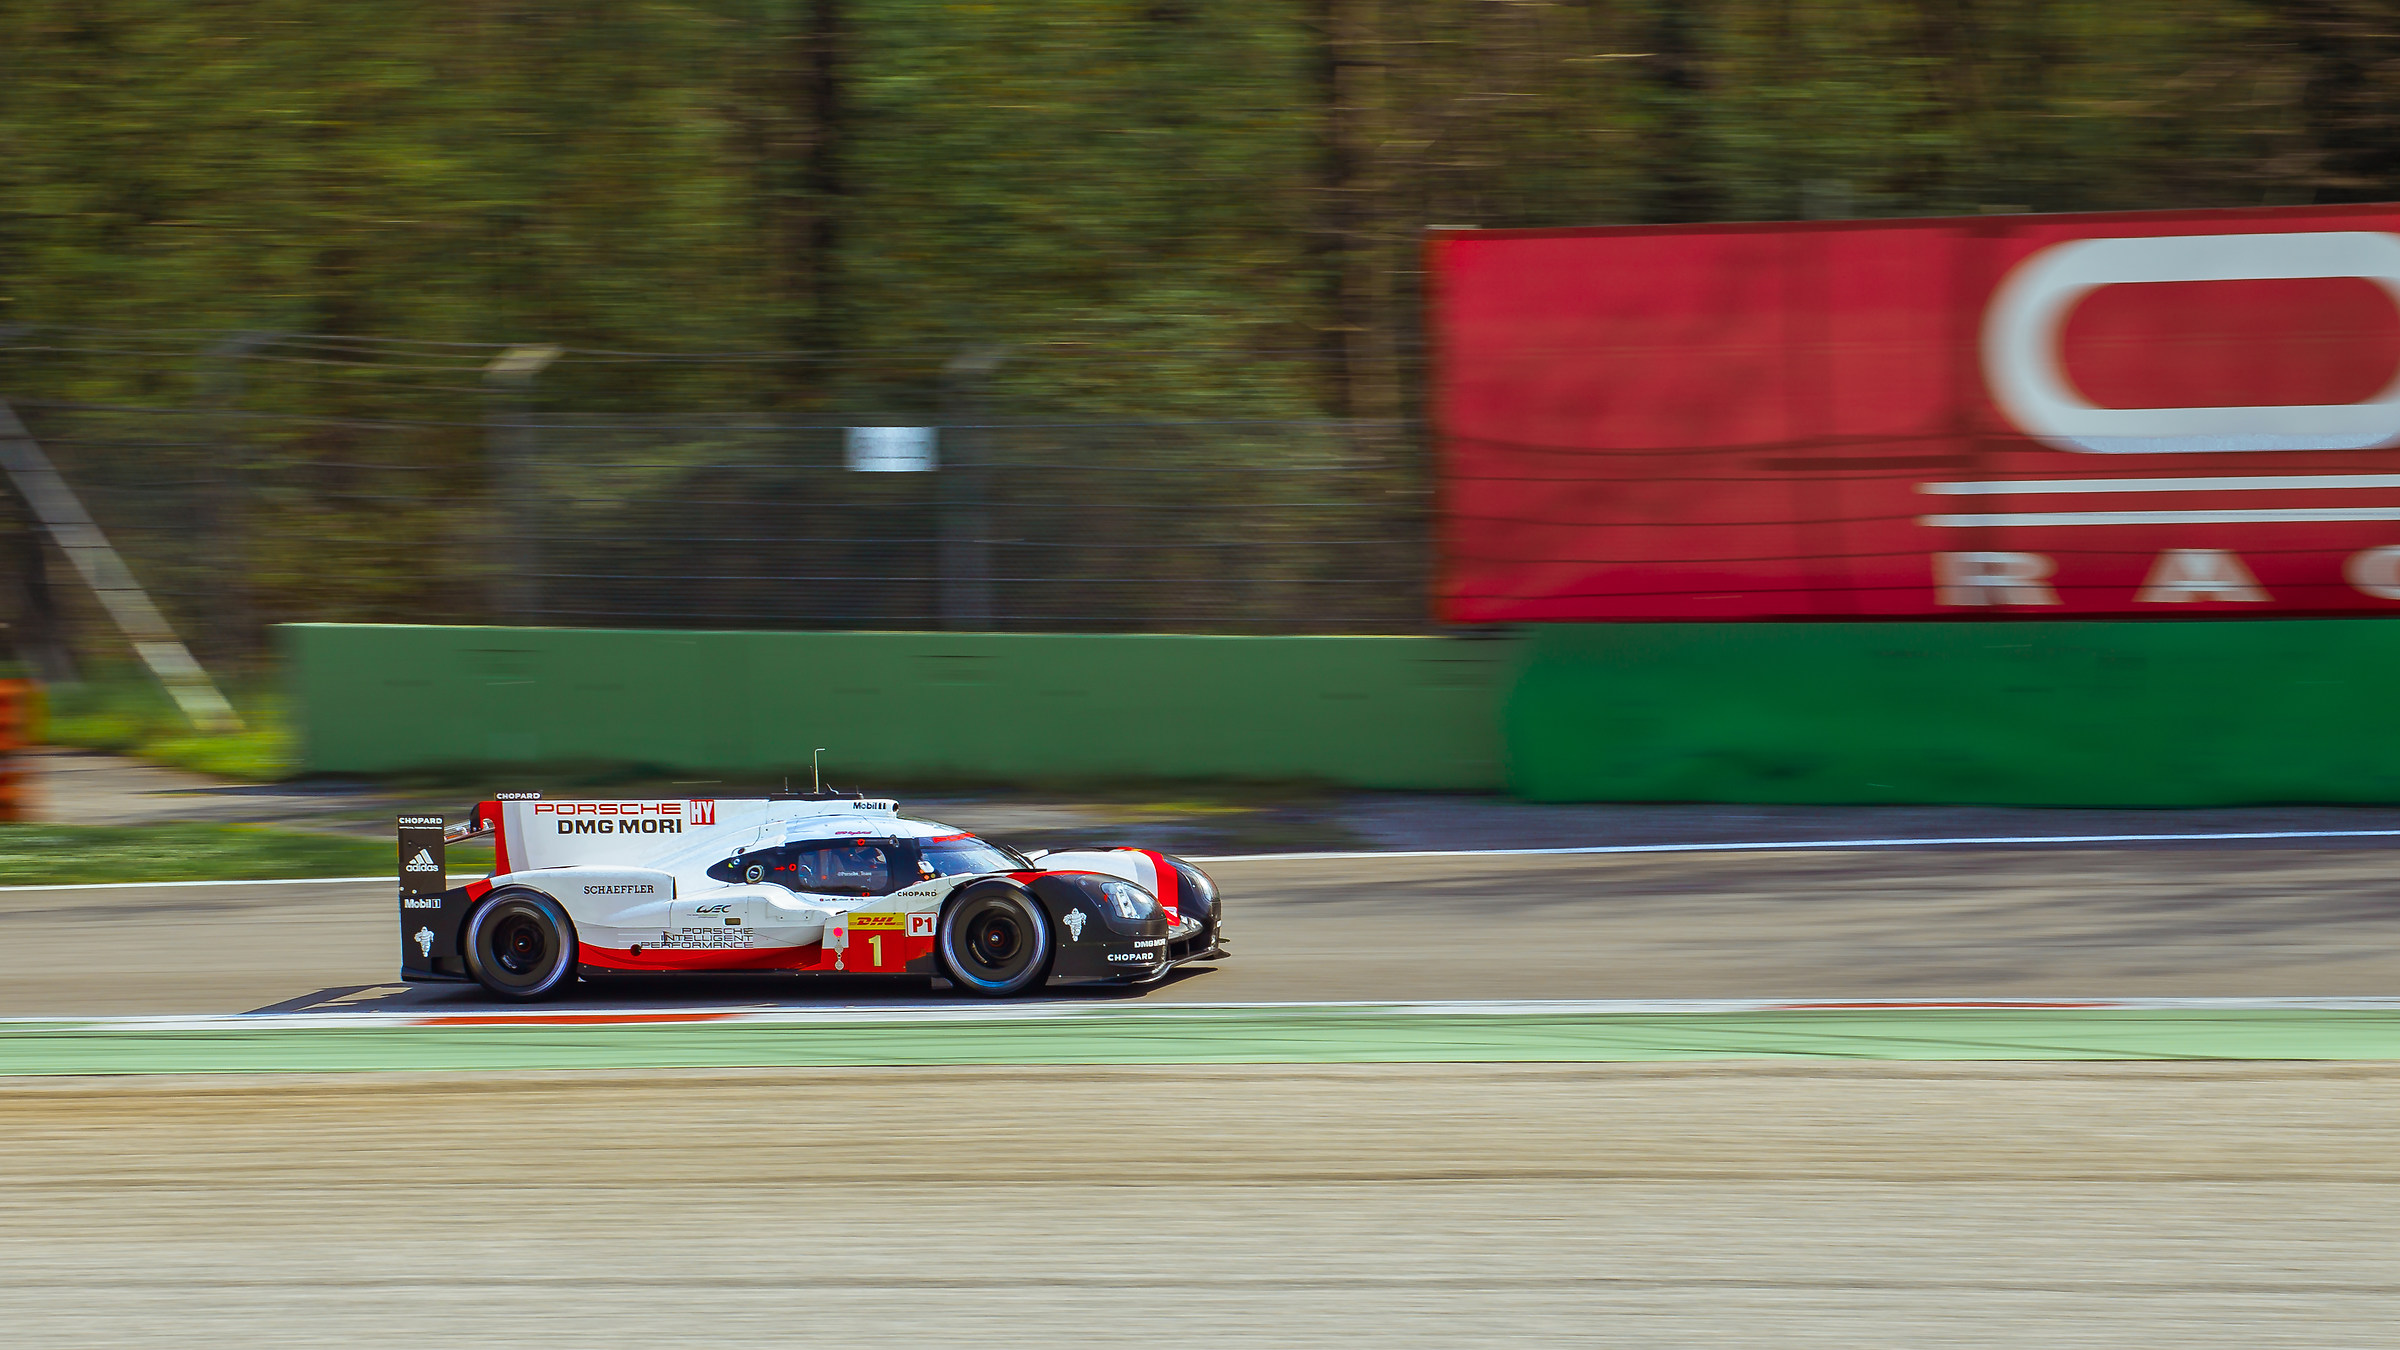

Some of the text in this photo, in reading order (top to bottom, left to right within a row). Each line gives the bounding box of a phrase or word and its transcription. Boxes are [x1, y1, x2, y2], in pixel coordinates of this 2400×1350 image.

[535, 803, 681, 815] PORSCHE
[853, 802, 877, 810] Mobil
[690, 801, 714, 824] HY
[558, 819, 682, 834] DMG MORI
[406, 864, 439, 872] adidas
[583, 885, 654, 895] SCHAEFFLER
[404, 899, 441, 909] Mobil 1
[696, 904, 731, 914] WEC
[856, 917, 896, 926] DHL
[912, 917, 933, 933] P1
[681, 927, 754, 935] PORSCHE
[661, 934, 754, 942] INTELLIGENT
[640, 941, 754, 949] PERFORMANCE
[868, 935, 882, 967] 1
[1107, 952, 1154, 961] CHOPARD
